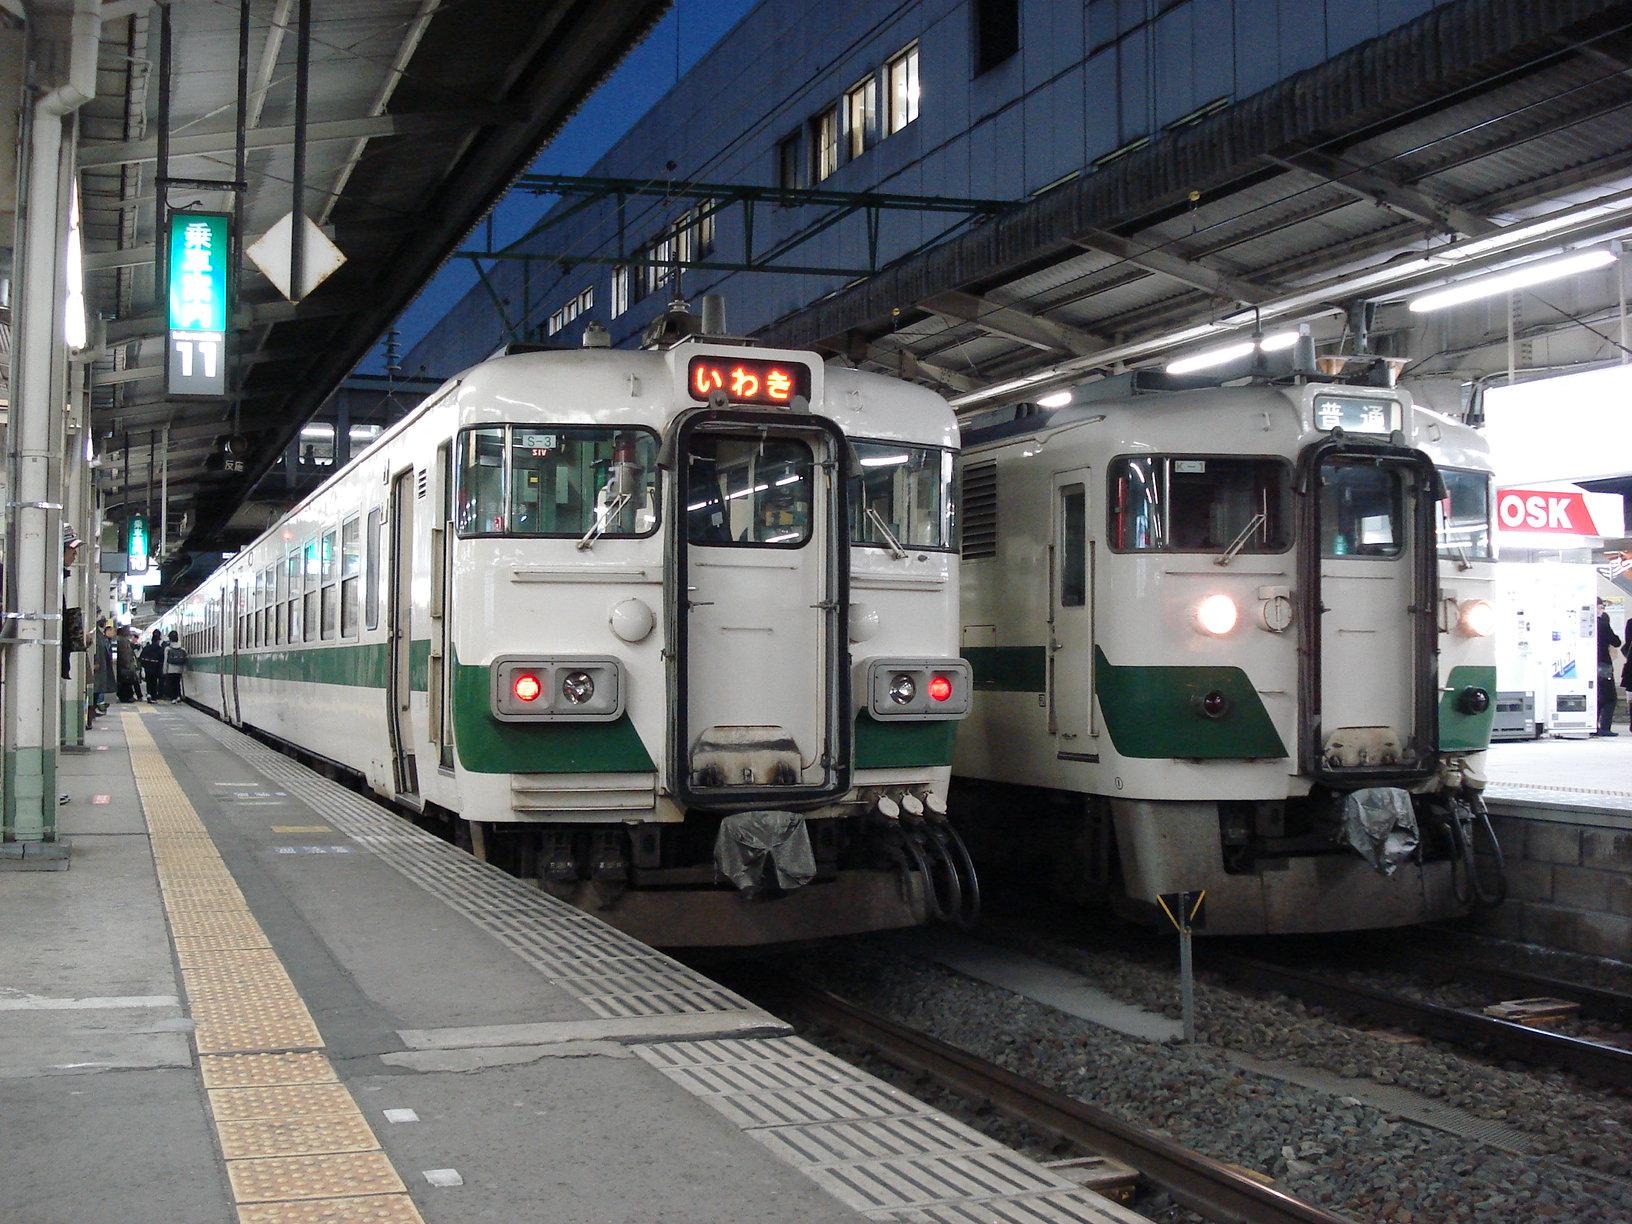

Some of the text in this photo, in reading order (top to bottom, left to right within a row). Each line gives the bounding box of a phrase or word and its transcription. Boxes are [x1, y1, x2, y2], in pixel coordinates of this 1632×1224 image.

[176, 342, 216, 377] 11
[697, 368, 790, 399] いわき
[1318, 402, 1386, 431] 普通
[528, 436, 551, 447] S-3
